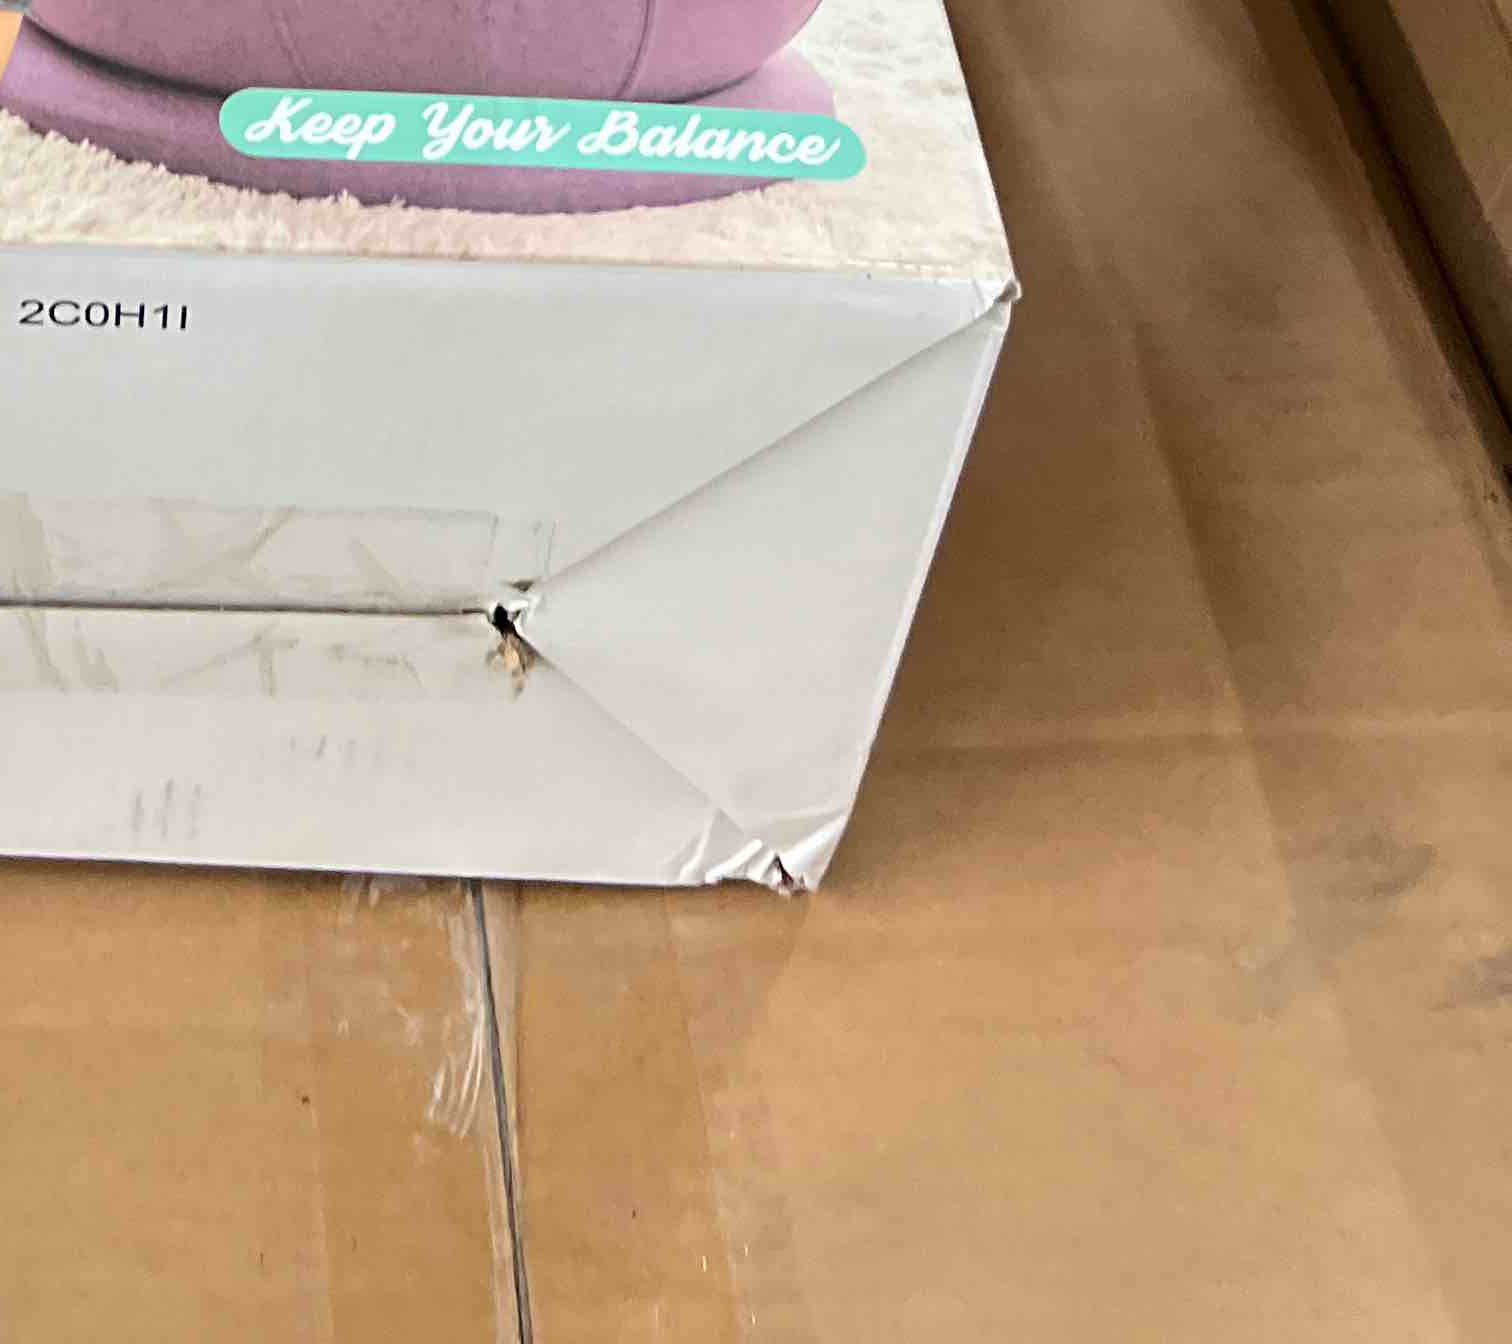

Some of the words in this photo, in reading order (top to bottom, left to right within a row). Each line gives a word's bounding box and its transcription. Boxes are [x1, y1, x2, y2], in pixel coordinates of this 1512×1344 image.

[243, 95, 397, 160] Keep
[421, 100, 572, 160] Your
[576, 109, 841, 165] Balance
